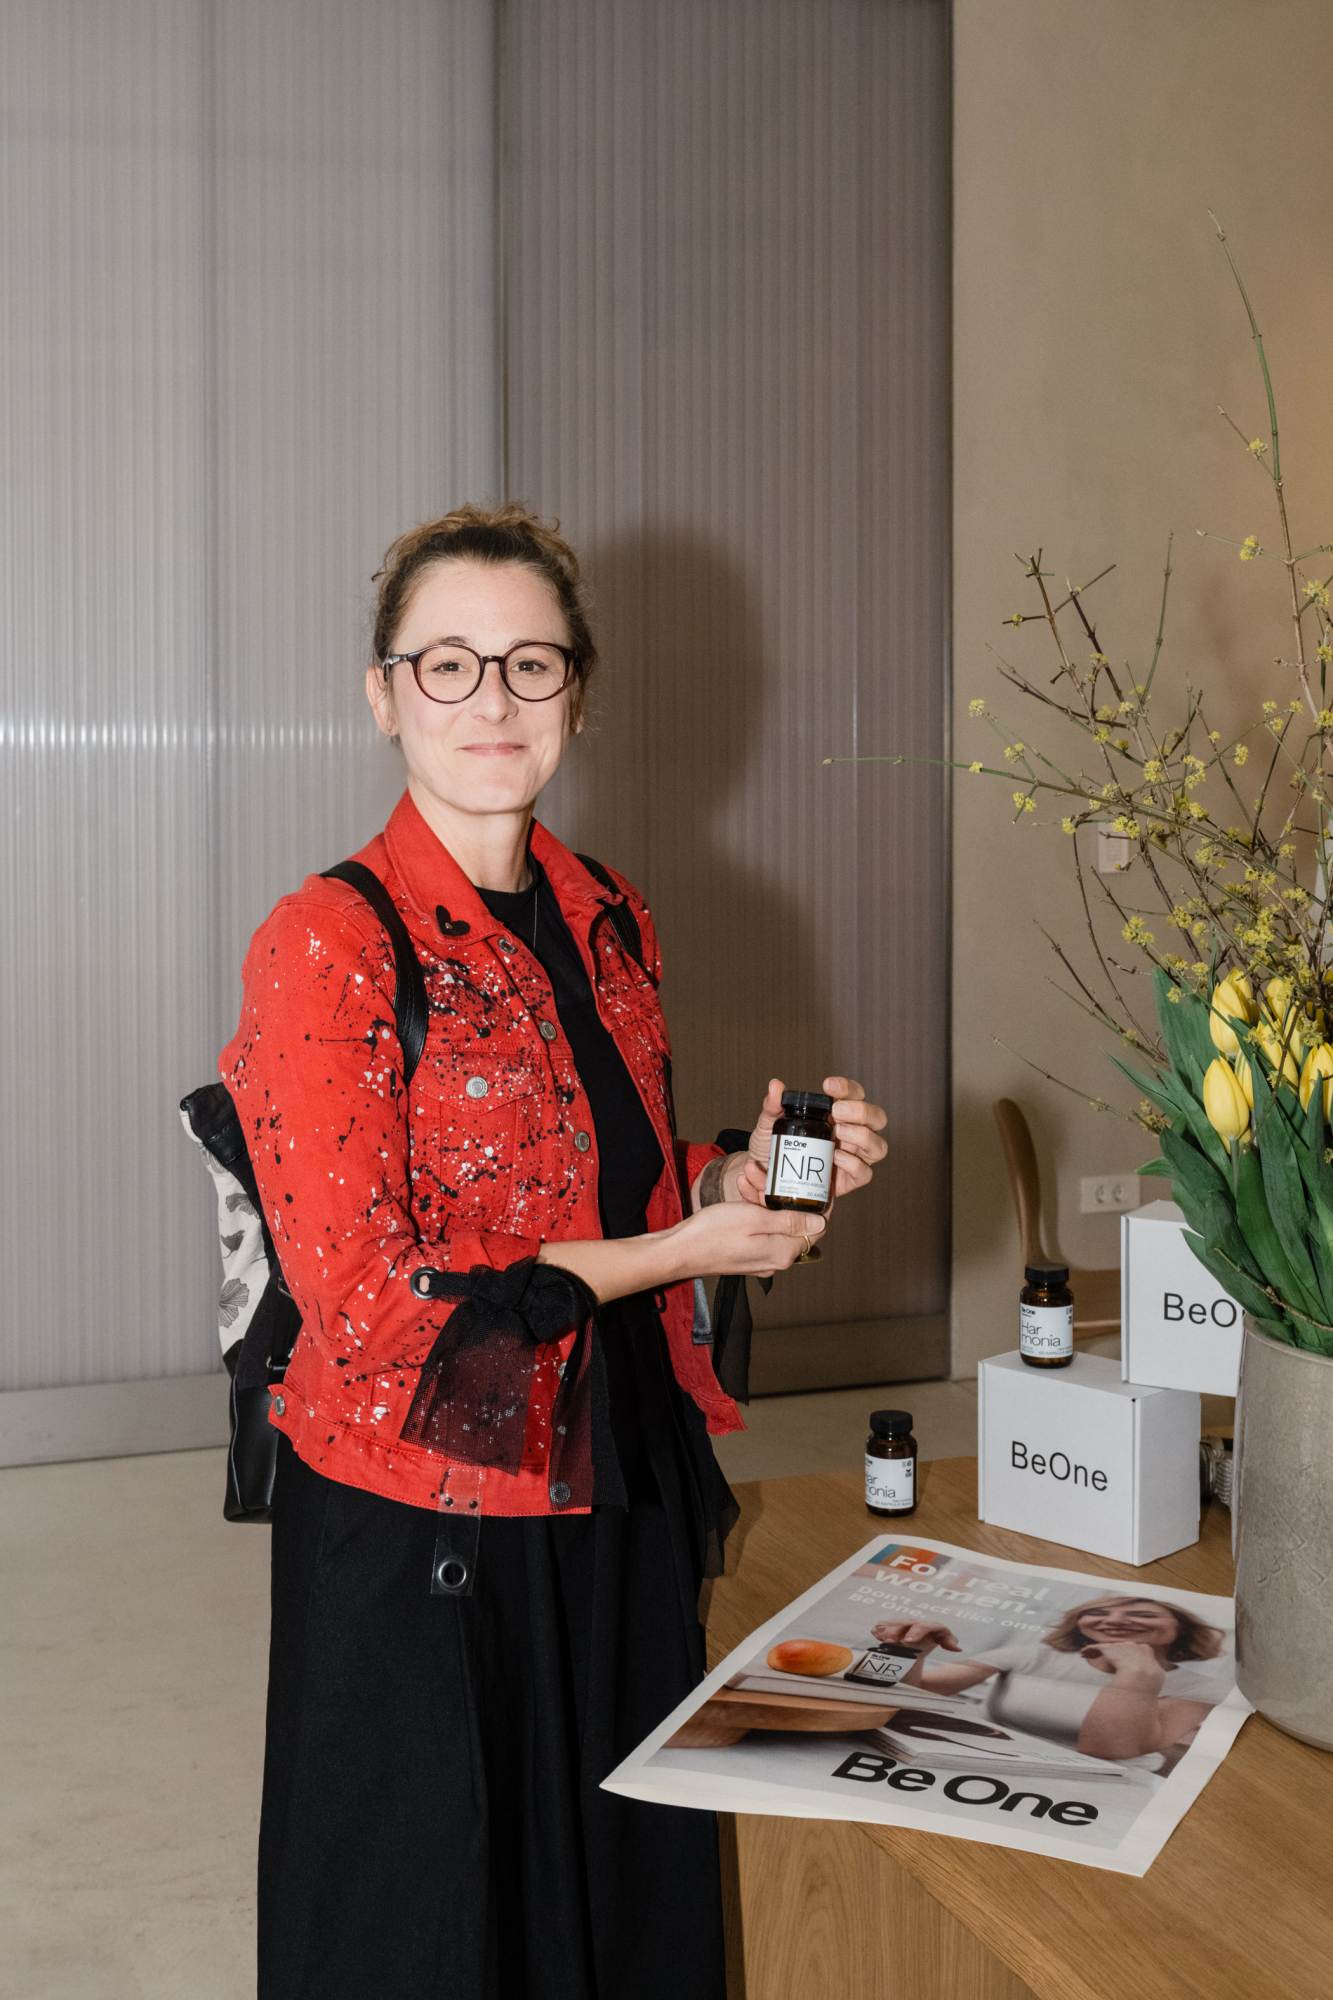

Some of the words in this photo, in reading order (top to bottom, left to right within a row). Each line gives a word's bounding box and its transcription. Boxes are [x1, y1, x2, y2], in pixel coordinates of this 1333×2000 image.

[784, 1139, 792, 1147] Be
[793, 1140, 807, 1148] One
[781, 1153, 825, 1183] NR
[1163, 1292, 1245, 1328] BeO
[1012, 1440, 1108, 1491] BeOne
[875, 1569, 1037, 1614] women.
[889, 1555, 958, 1580] For
[965, 1577, 1050, 1601] real
[862, 1660, 902, 1676] NR
[831, 1751, 936, 1792] Be
[943, 1775, 1099, 1826] One
